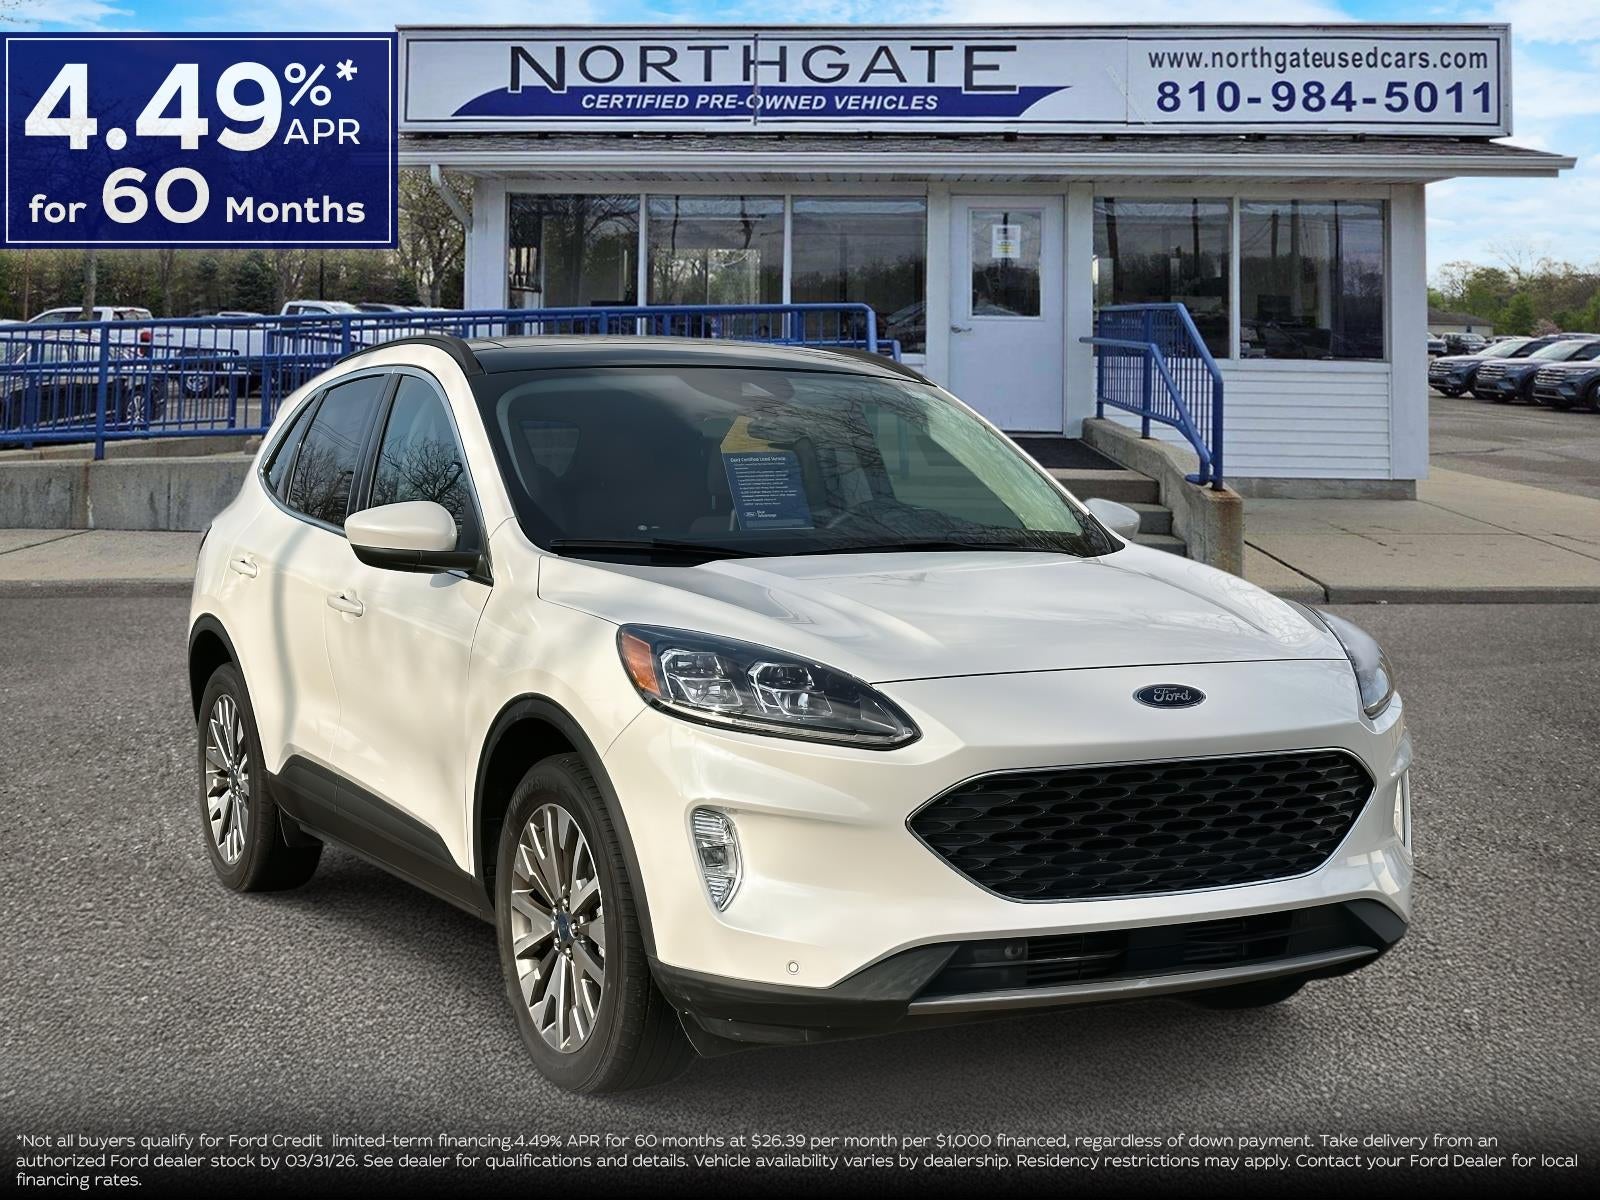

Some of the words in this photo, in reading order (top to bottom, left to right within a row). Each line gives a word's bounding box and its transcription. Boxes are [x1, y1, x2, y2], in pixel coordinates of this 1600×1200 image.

[509, 44, 1018, 92] NORTHGATE
[1148, 46, 1489, 74] www.northgateusedcars.com
[581, 93, 690, 110] CERTIFIED
[694, 93, 827, 111] PRE-OWNED
[834, 94, 939, 112] VEHICLES
[1156, 80, 1491, 114] 810-984-5011
[1153, 687, 1192, 702] Ford
